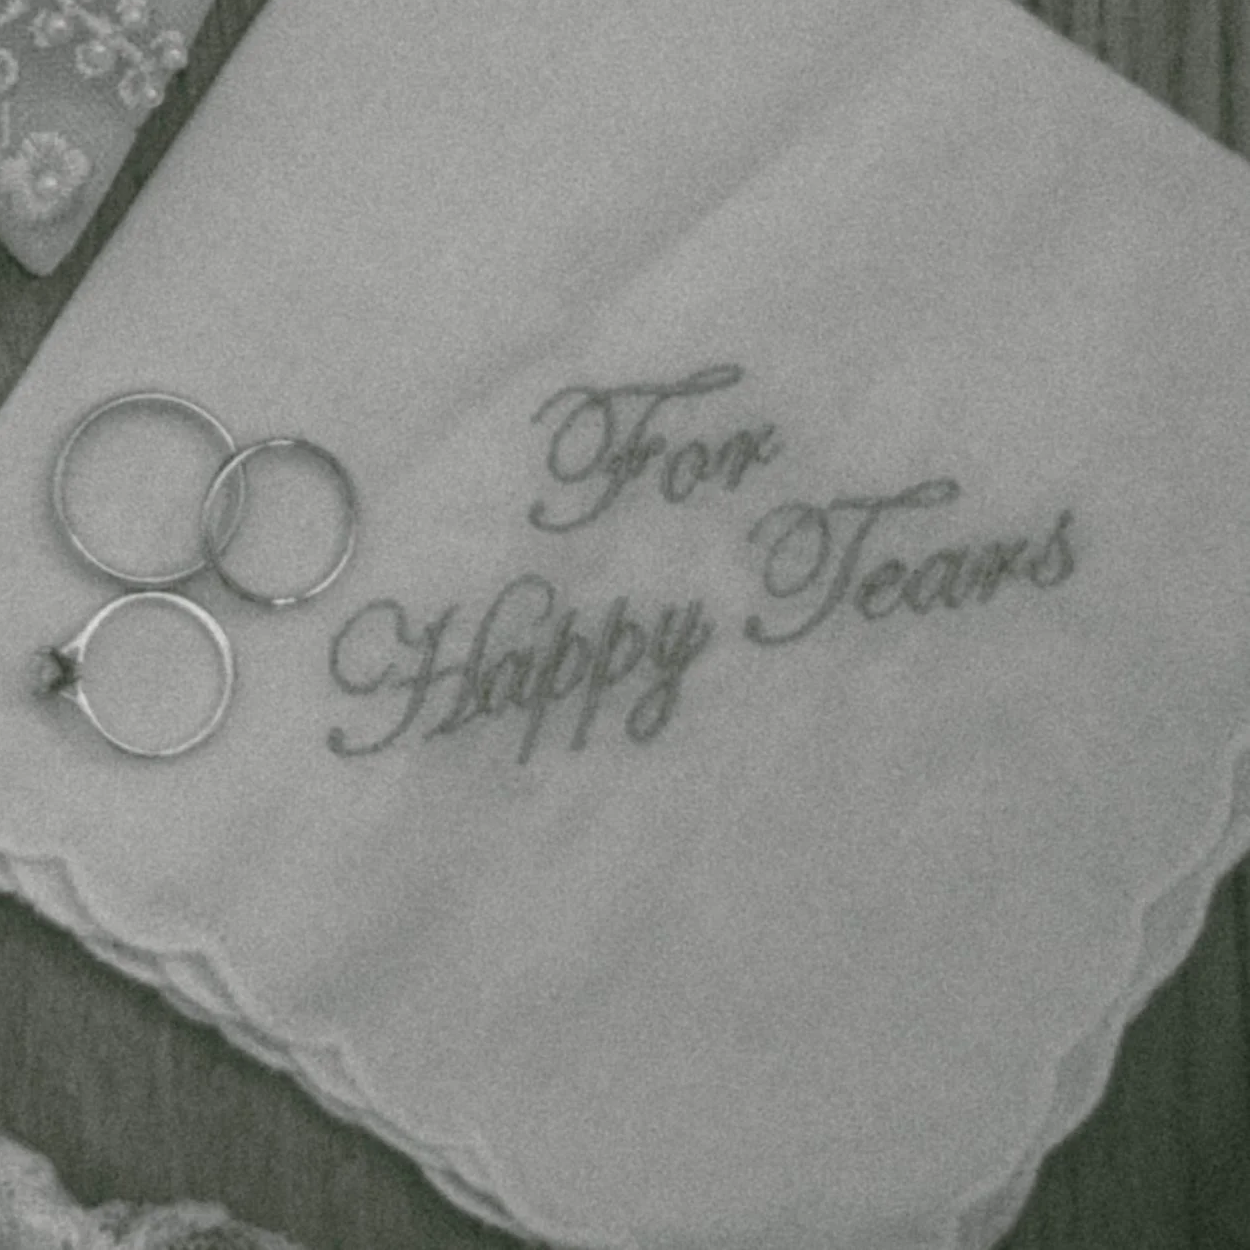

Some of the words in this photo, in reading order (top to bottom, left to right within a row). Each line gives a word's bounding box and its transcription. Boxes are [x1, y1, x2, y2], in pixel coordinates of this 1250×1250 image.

[529, 364, 783, 534] For
[327, 574, 713, 764] Happy
[744, 478, 1075, 646] Tears
